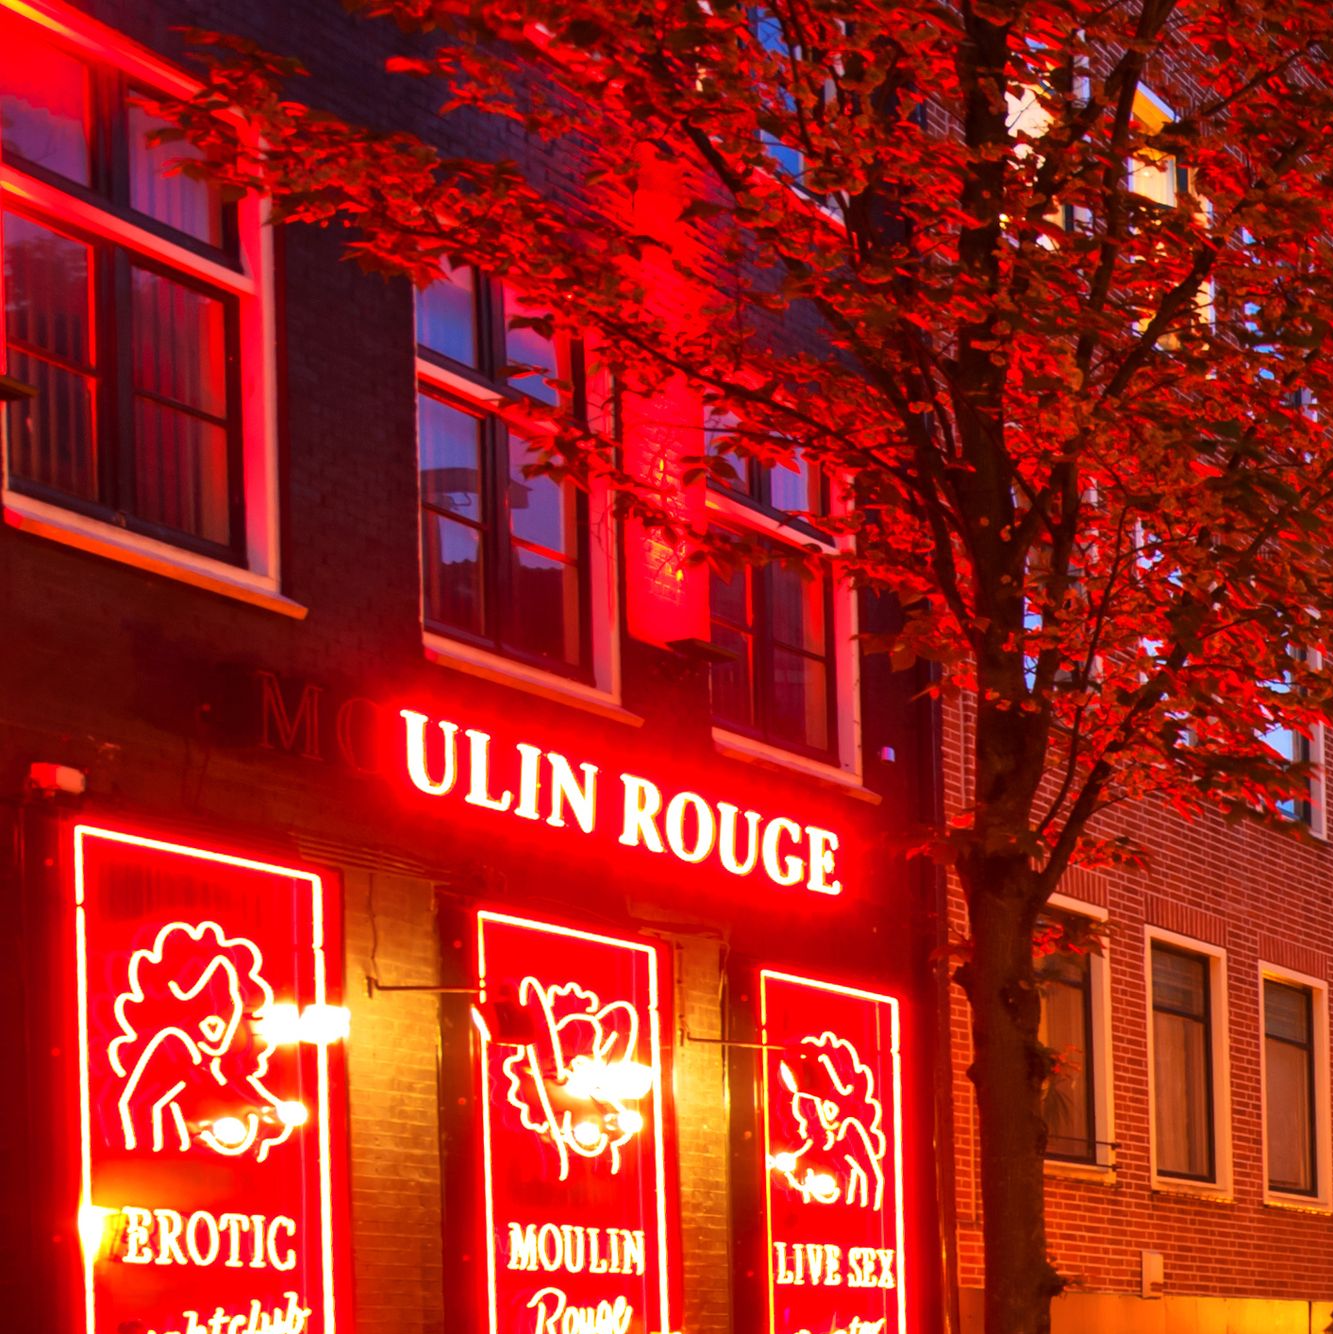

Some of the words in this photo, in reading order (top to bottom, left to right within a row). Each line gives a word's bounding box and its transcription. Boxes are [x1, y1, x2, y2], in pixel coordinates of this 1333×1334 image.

[618, 772, 843, 896] ROUGE
[121, 1206, 297, 1272] EROTIC
[507, 1222, 645, 1276] MOULIN
[773, 1241, 843, 1286] LIVE
[847, 1246, 896, 1289] SEX
